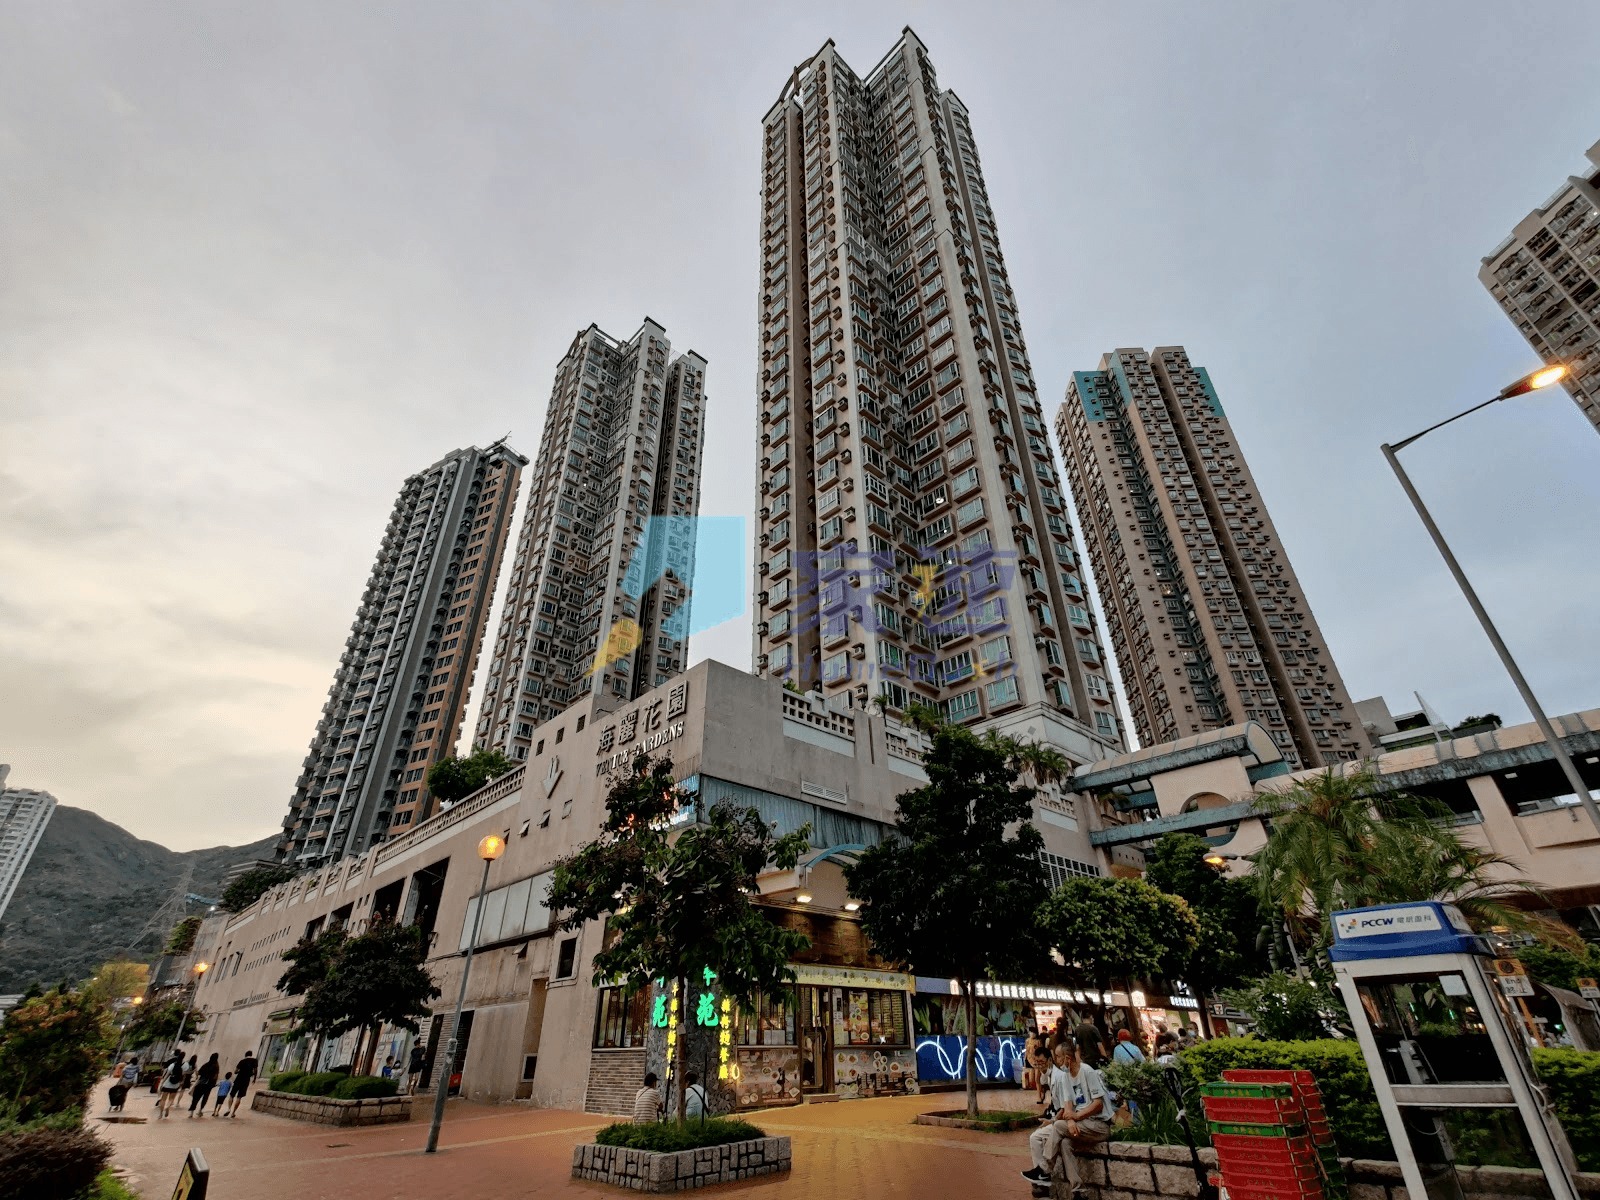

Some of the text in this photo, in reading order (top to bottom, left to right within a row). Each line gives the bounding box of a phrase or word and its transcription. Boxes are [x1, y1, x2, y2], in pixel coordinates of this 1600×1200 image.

[596, 679, 689, 757] 海麗花園
[633, 721, 685, 757] GARDENS
[1361, 917, 1394, 928] PCCW
